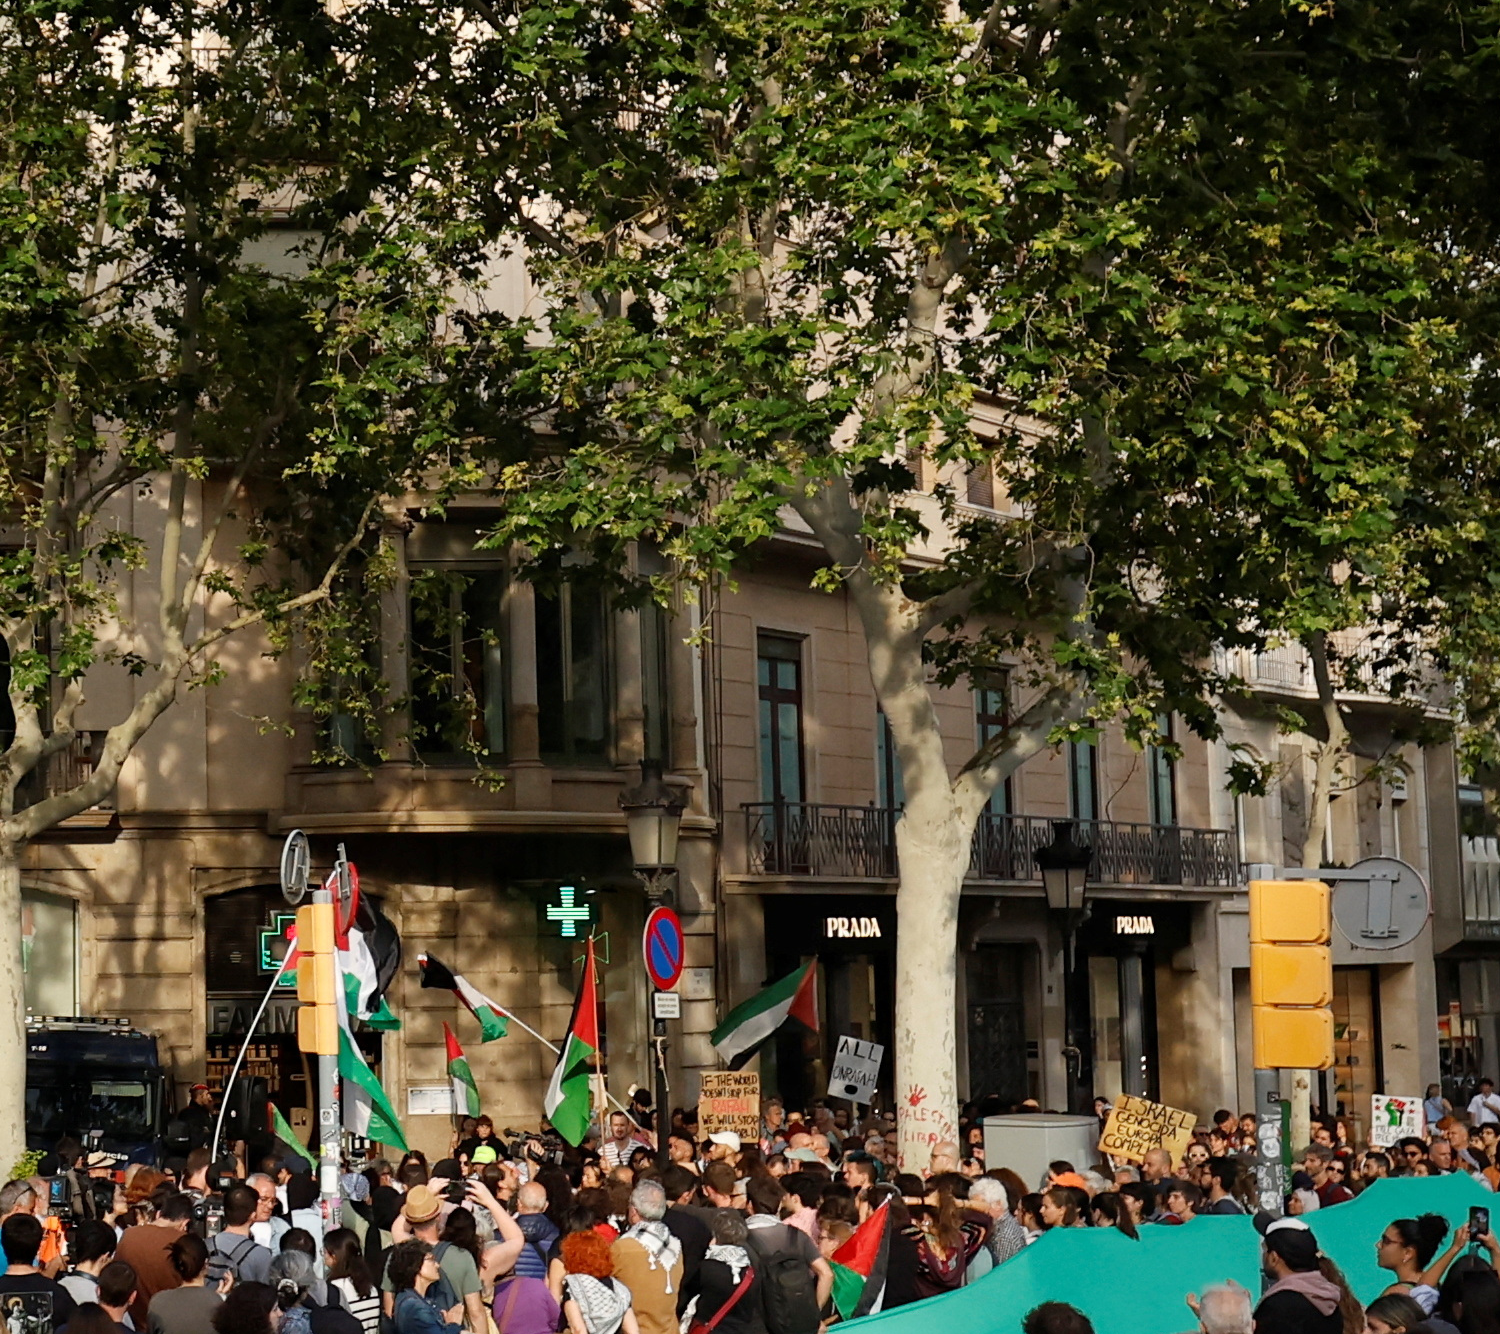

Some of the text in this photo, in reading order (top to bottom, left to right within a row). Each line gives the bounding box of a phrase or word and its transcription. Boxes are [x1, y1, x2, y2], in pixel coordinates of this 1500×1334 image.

[827, 917, 881, 938] PRADA
[1117, 916, 1154, 934] PRADA
[839, 1038, 878, 1063] ALL
[701, 1073, 757, 1087] IF THE WORLD
[711, 1098, 751, 1114] RAFAH
[1118, 1095, 1190, 1129] ISRAEL
[702, 1114, 758, 1125] WE WILL STOP
